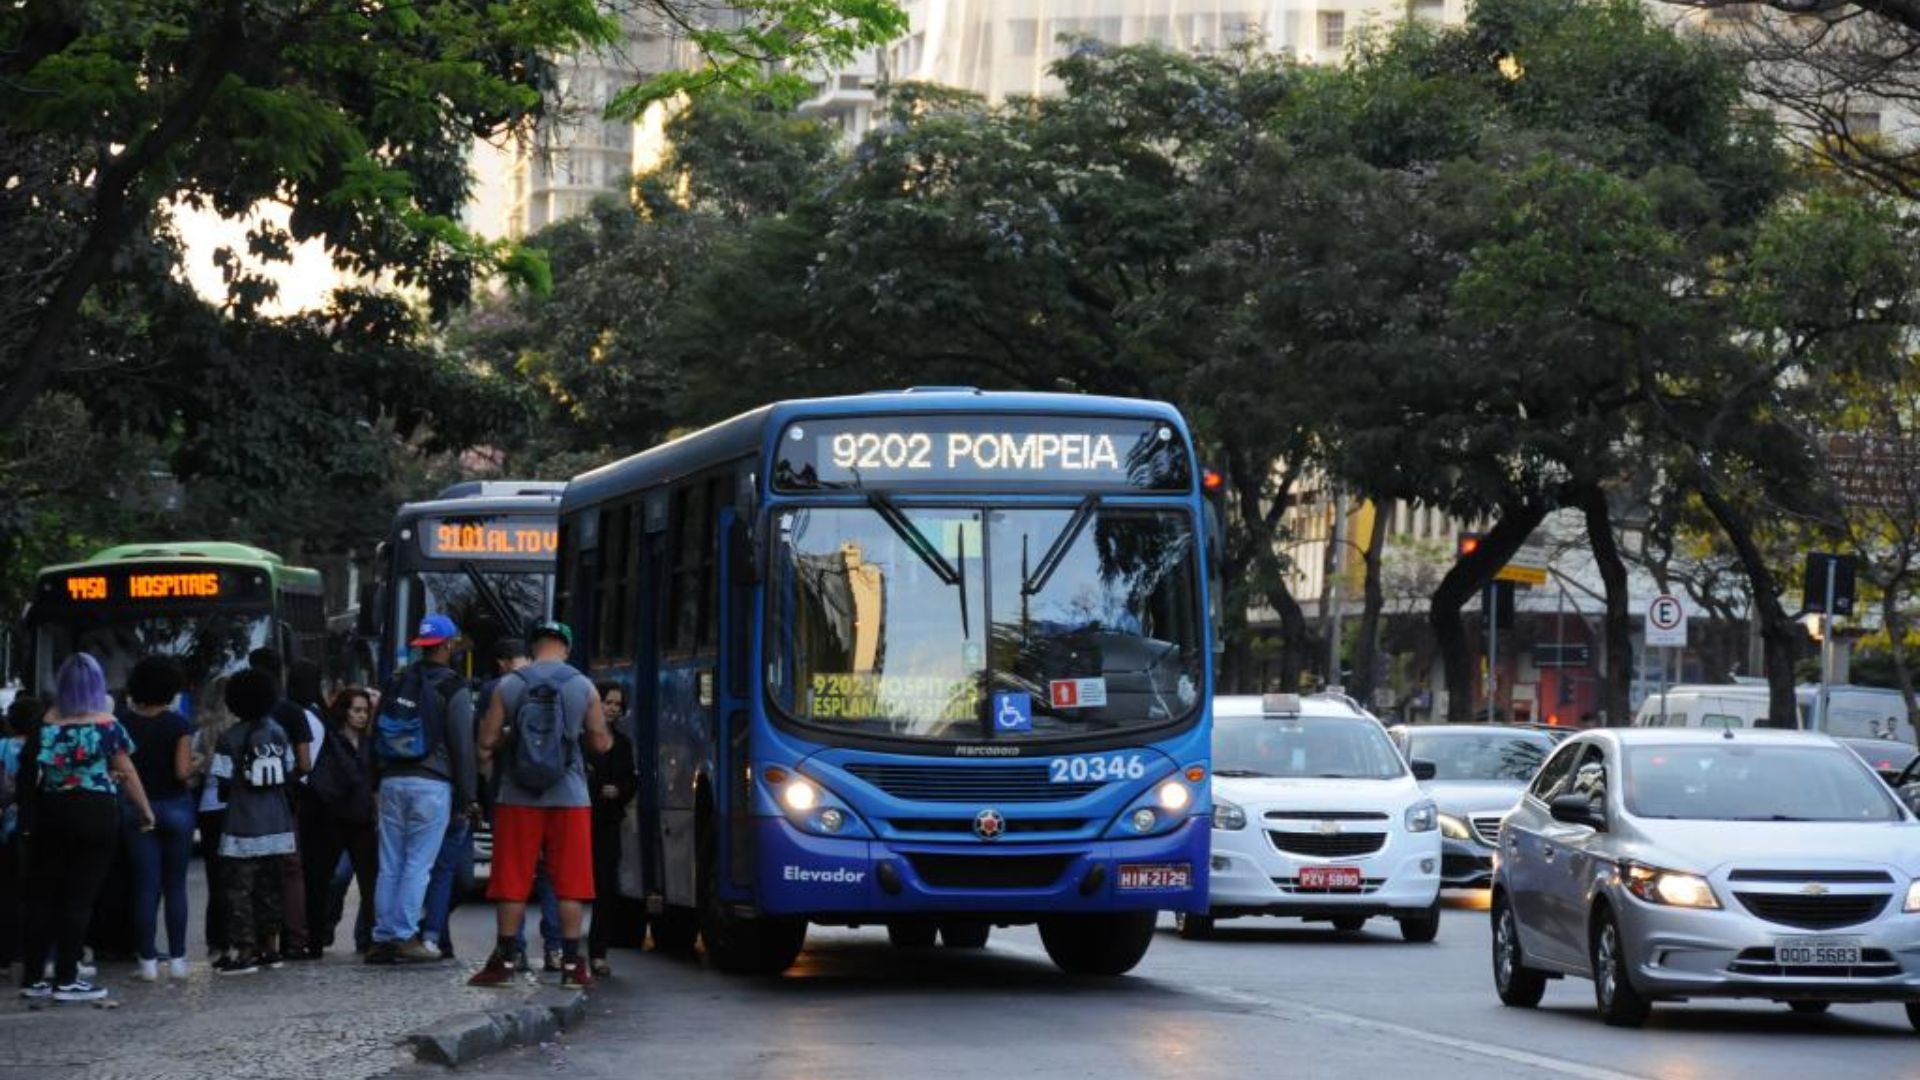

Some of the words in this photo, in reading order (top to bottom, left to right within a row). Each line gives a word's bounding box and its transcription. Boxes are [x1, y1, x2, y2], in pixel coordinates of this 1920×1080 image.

[833, 433, 932, 468] 9202
[947, 433, 1119, 469] POMPEIA
[437, 524, 485, 552] 9101
[130, 573, 219, 597] HOSPITAIS
[1659, 602, 1673, 623] E
[1050, 754, 1146, 783] 20346
[783, 865, 866, 883] Elevador
